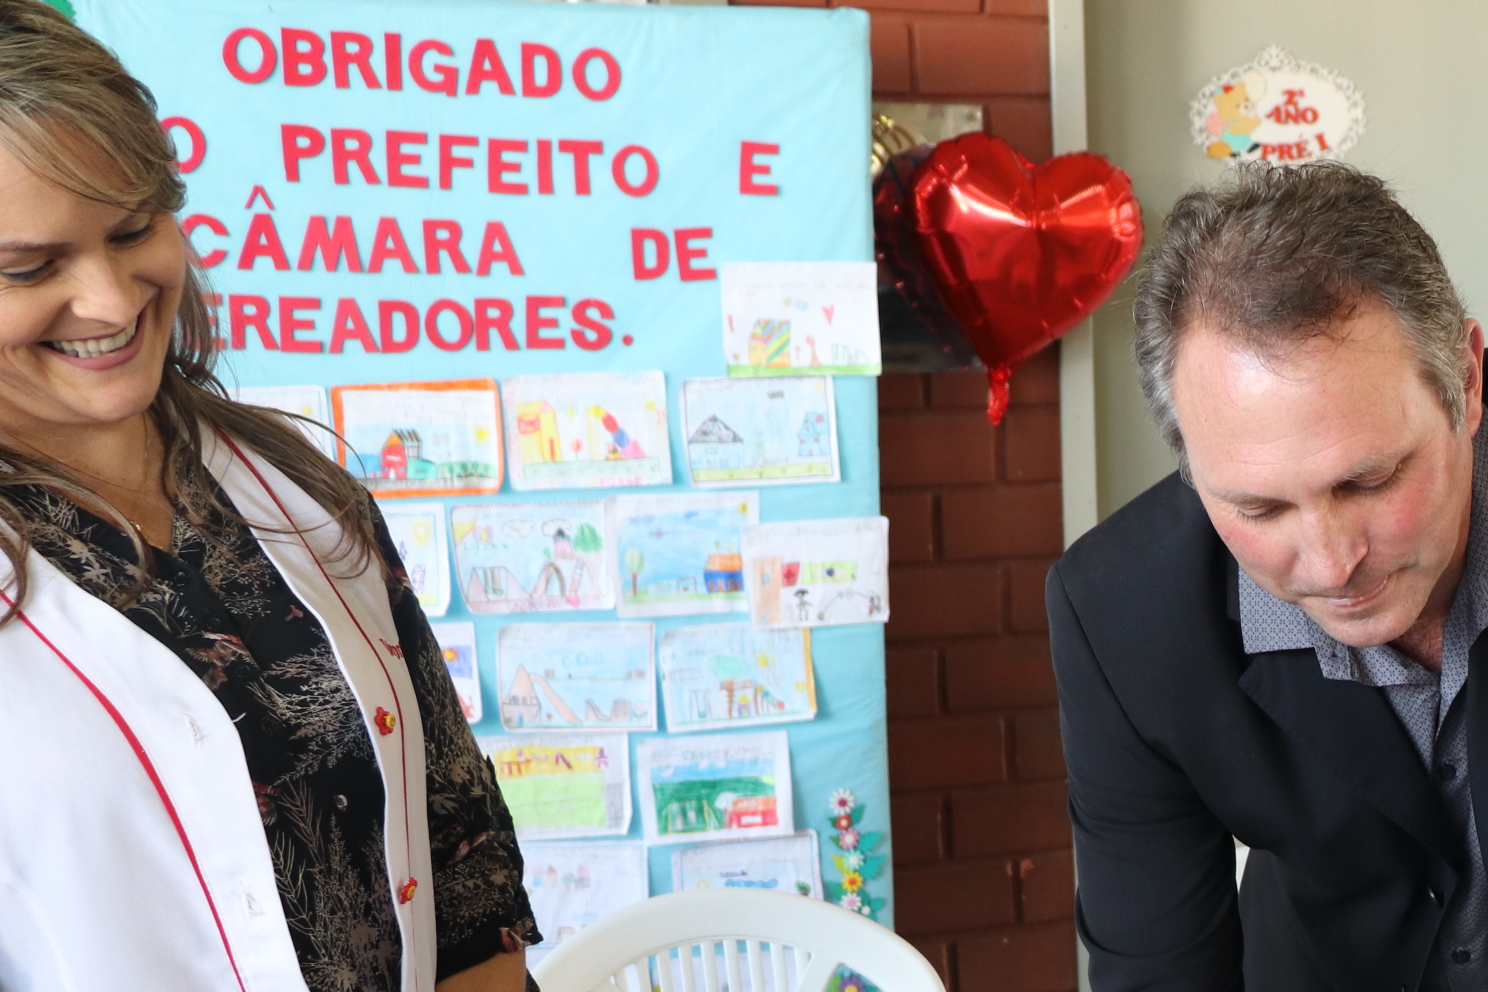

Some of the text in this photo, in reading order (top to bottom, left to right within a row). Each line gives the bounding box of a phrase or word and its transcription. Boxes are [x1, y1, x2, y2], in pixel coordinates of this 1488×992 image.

[222, 28, 621, 101] OBRIGADO
[1265, 105, 1319, 125] ANO
[281, 124, 659, 198] PREFEITO
[740, 141, 779, 196] E
[181, 186, 717, 282] CÂMARA DE
